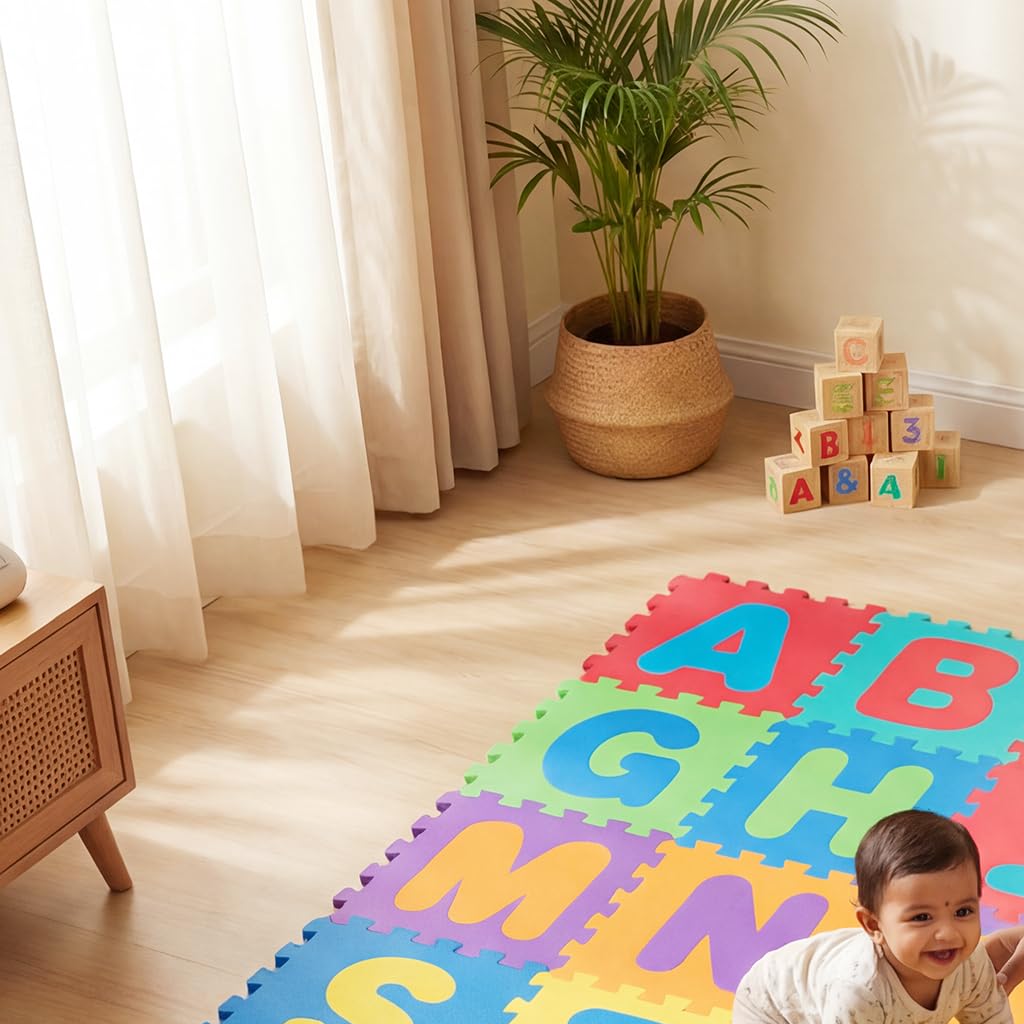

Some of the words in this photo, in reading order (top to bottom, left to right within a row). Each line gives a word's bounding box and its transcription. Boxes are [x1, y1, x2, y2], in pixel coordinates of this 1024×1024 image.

[843, 338, 868, 365] C
[820, 431, 839, 459] B
[902, 417, 921, 443] 3
[789, 478, 814, 505] A
[835, 467, 858, 494] &
[878, 475, 901, 500] A
[637, 604, 789, 692] A
[856, 637, 1019, 730] B
[542, 708, 699, 808] G
[745, 747, 934, 859] H
[395, 821, 611, 940] M
[636, 874, 829, 993] N
